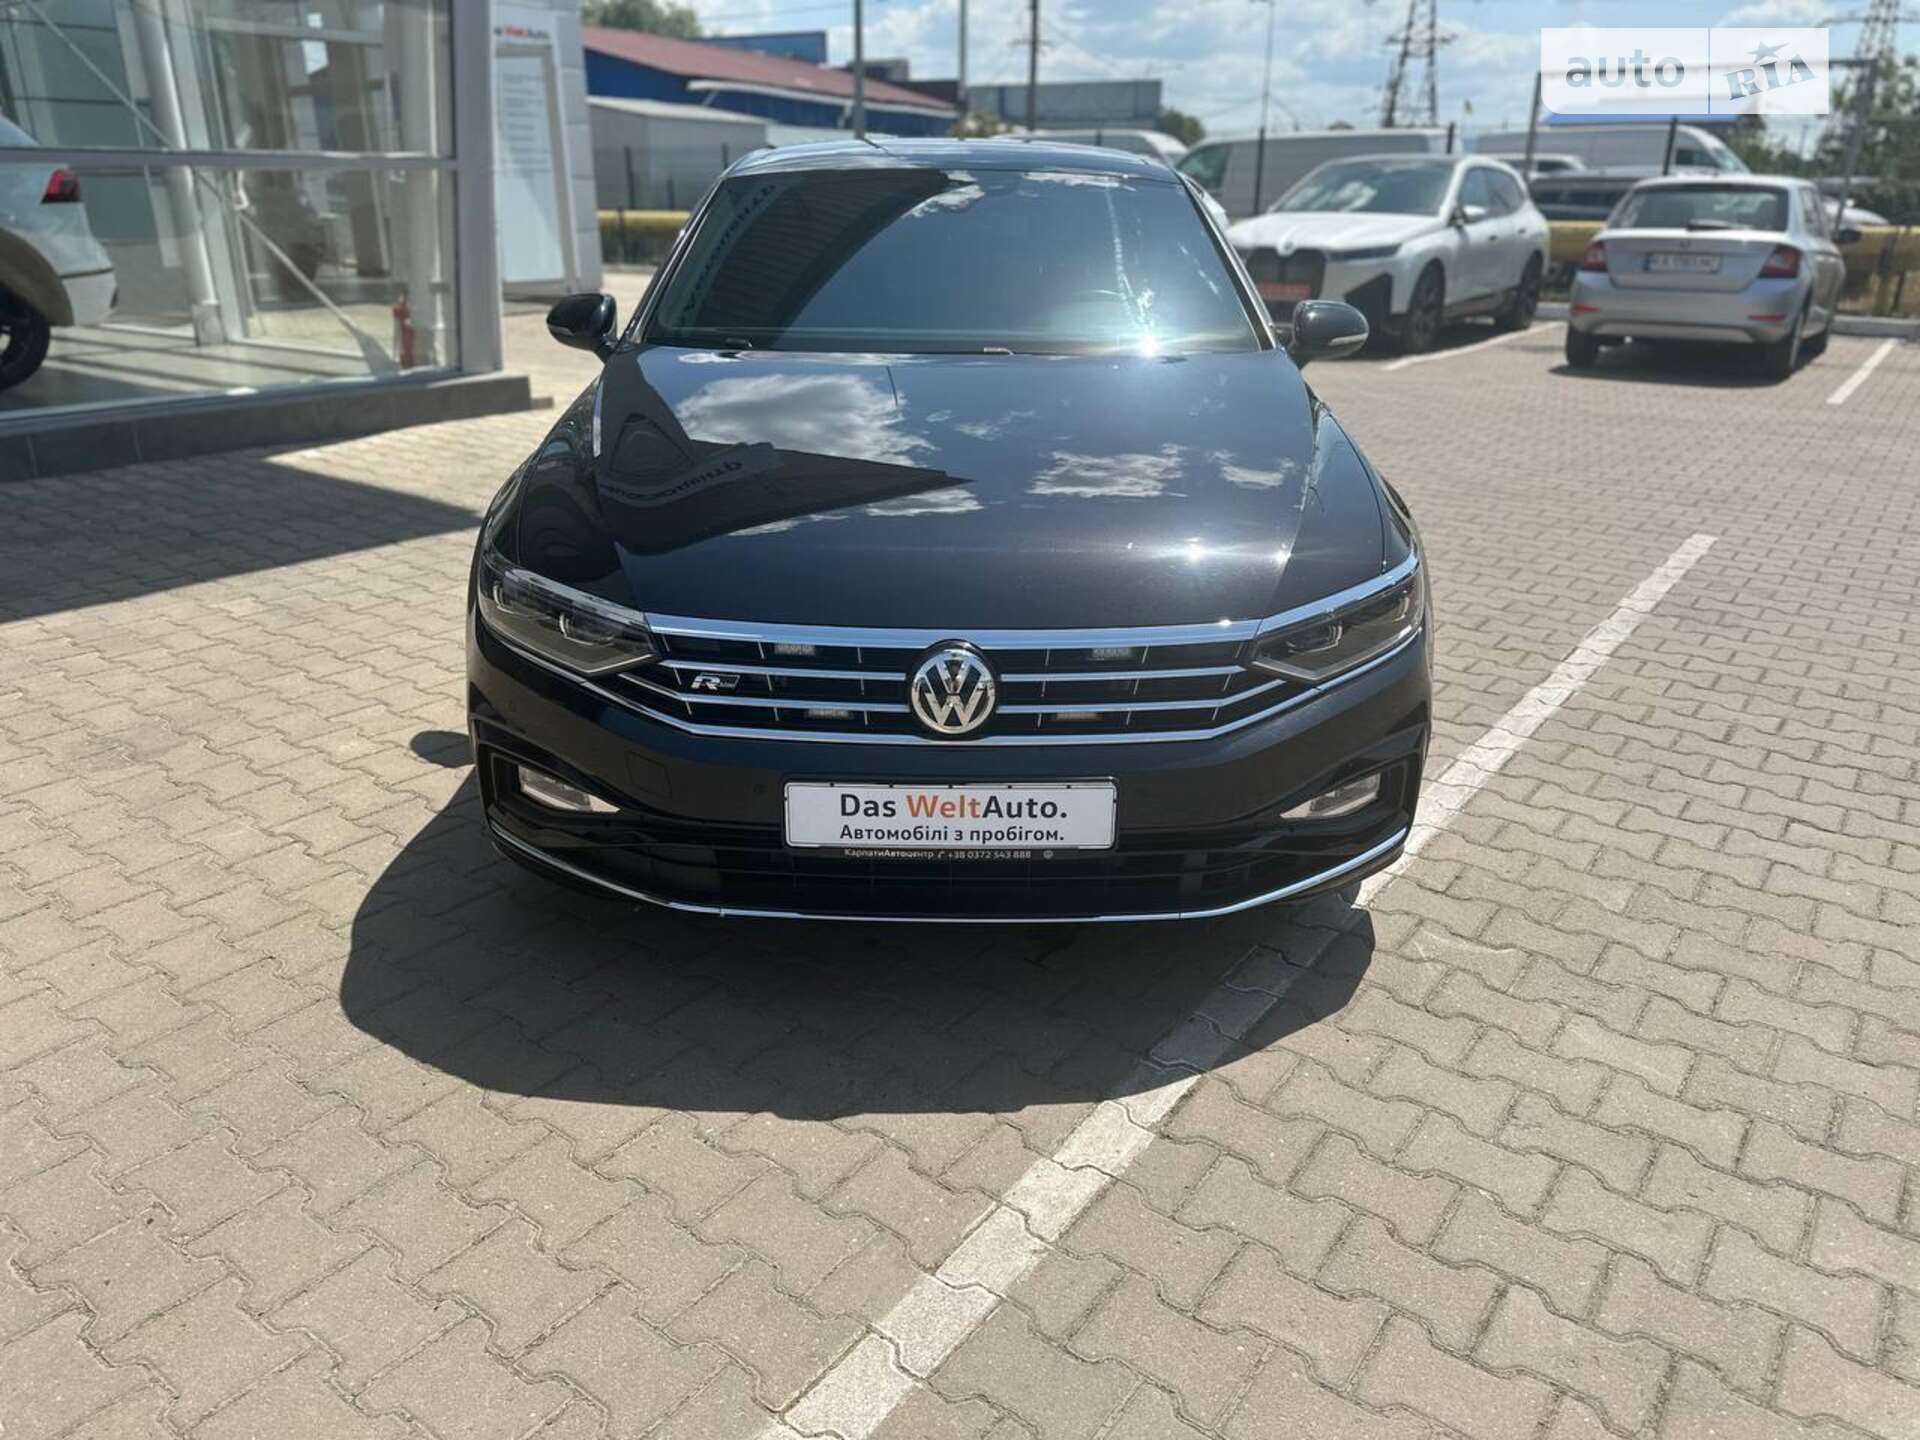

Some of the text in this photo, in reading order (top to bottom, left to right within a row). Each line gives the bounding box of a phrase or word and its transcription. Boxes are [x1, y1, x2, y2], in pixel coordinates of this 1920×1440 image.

[840, 793, 1068, 819] Das WeltAuto.
[840, 824, 1065, 844] Автомобілі з пробігом.
